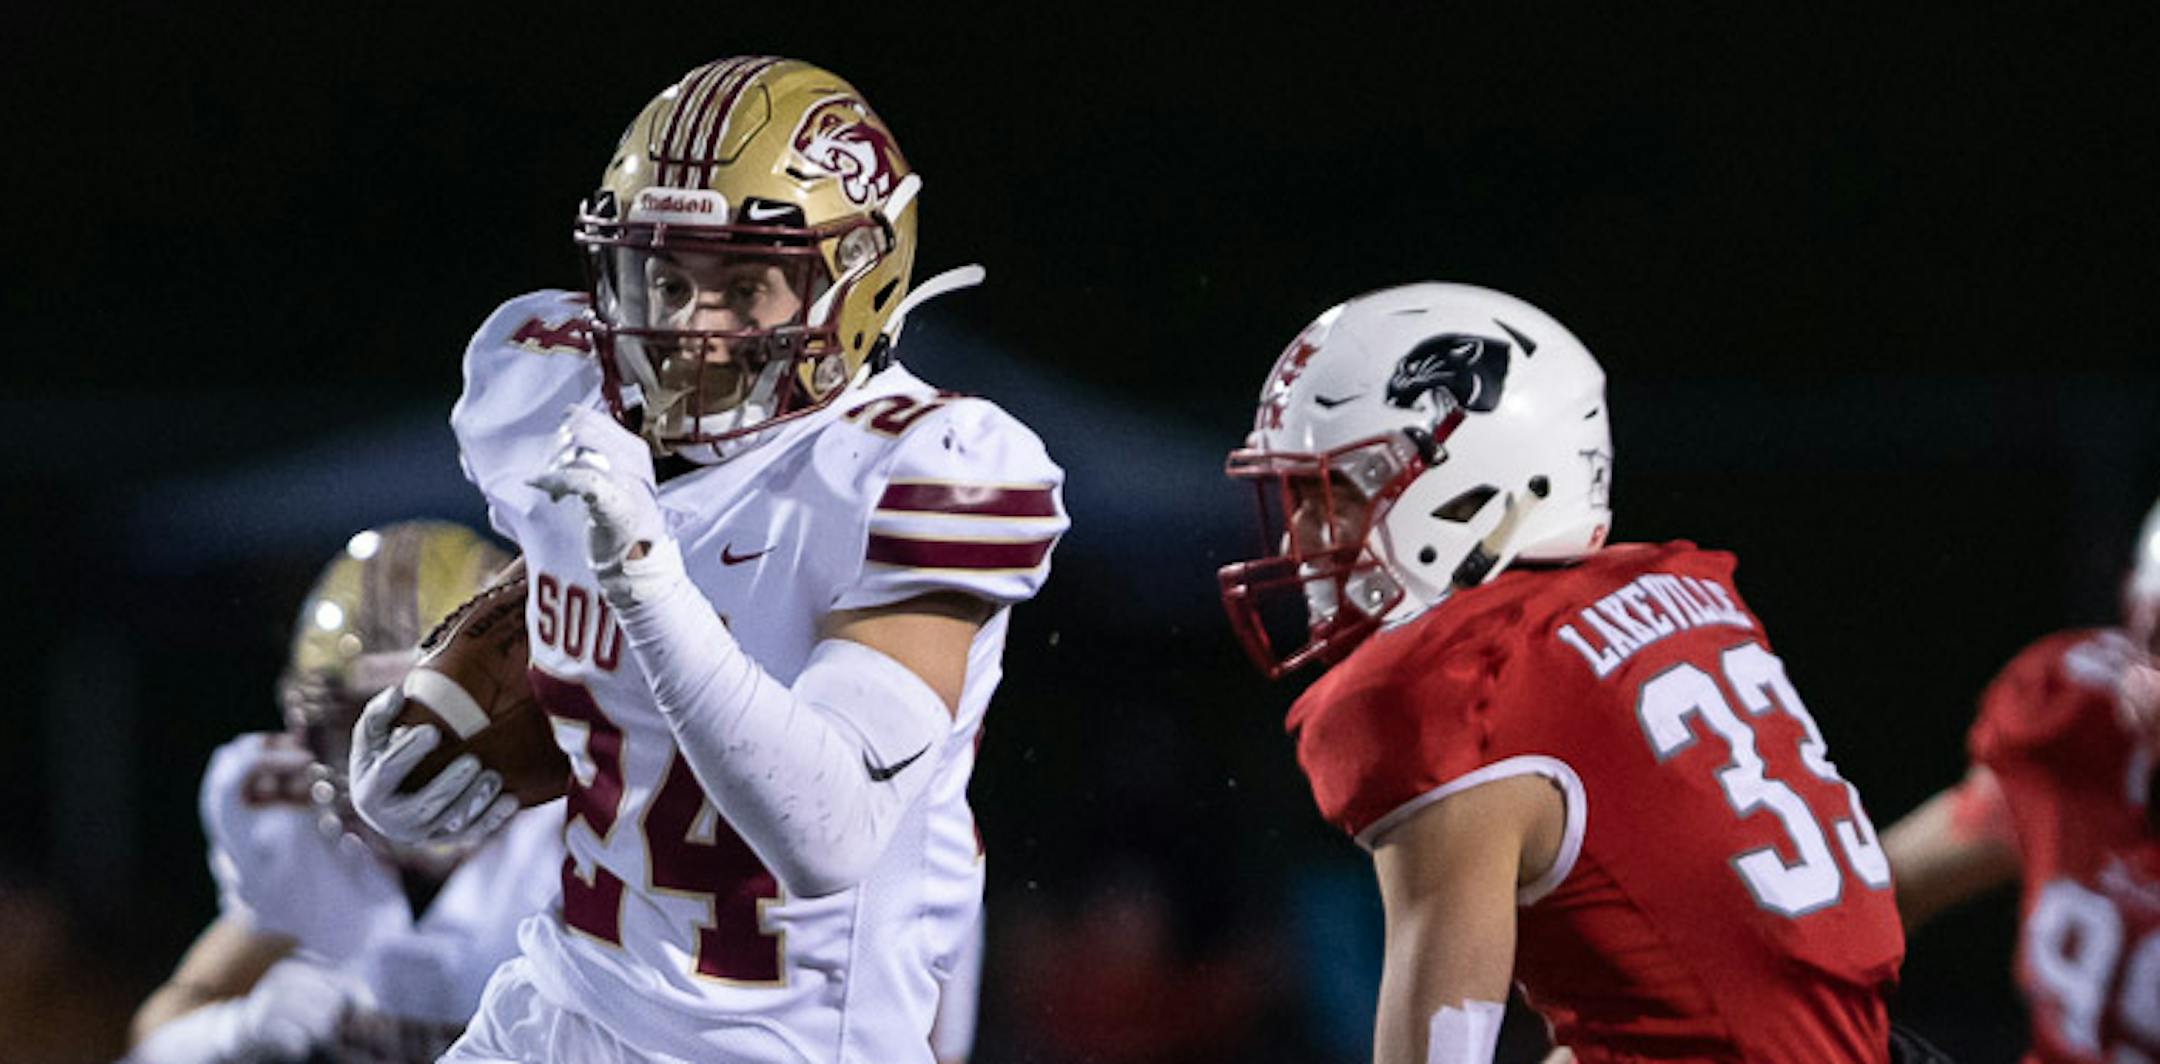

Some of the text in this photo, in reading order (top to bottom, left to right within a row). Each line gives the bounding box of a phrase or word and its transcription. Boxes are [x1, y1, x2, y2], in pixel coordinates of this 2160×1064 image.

[536, 573, 625, 673] SOU
[1556, 572, 1755, 680] LAKEVILLE
[527, 661, 788, 988] 24
[1636, 640, 1893, 918] 33
